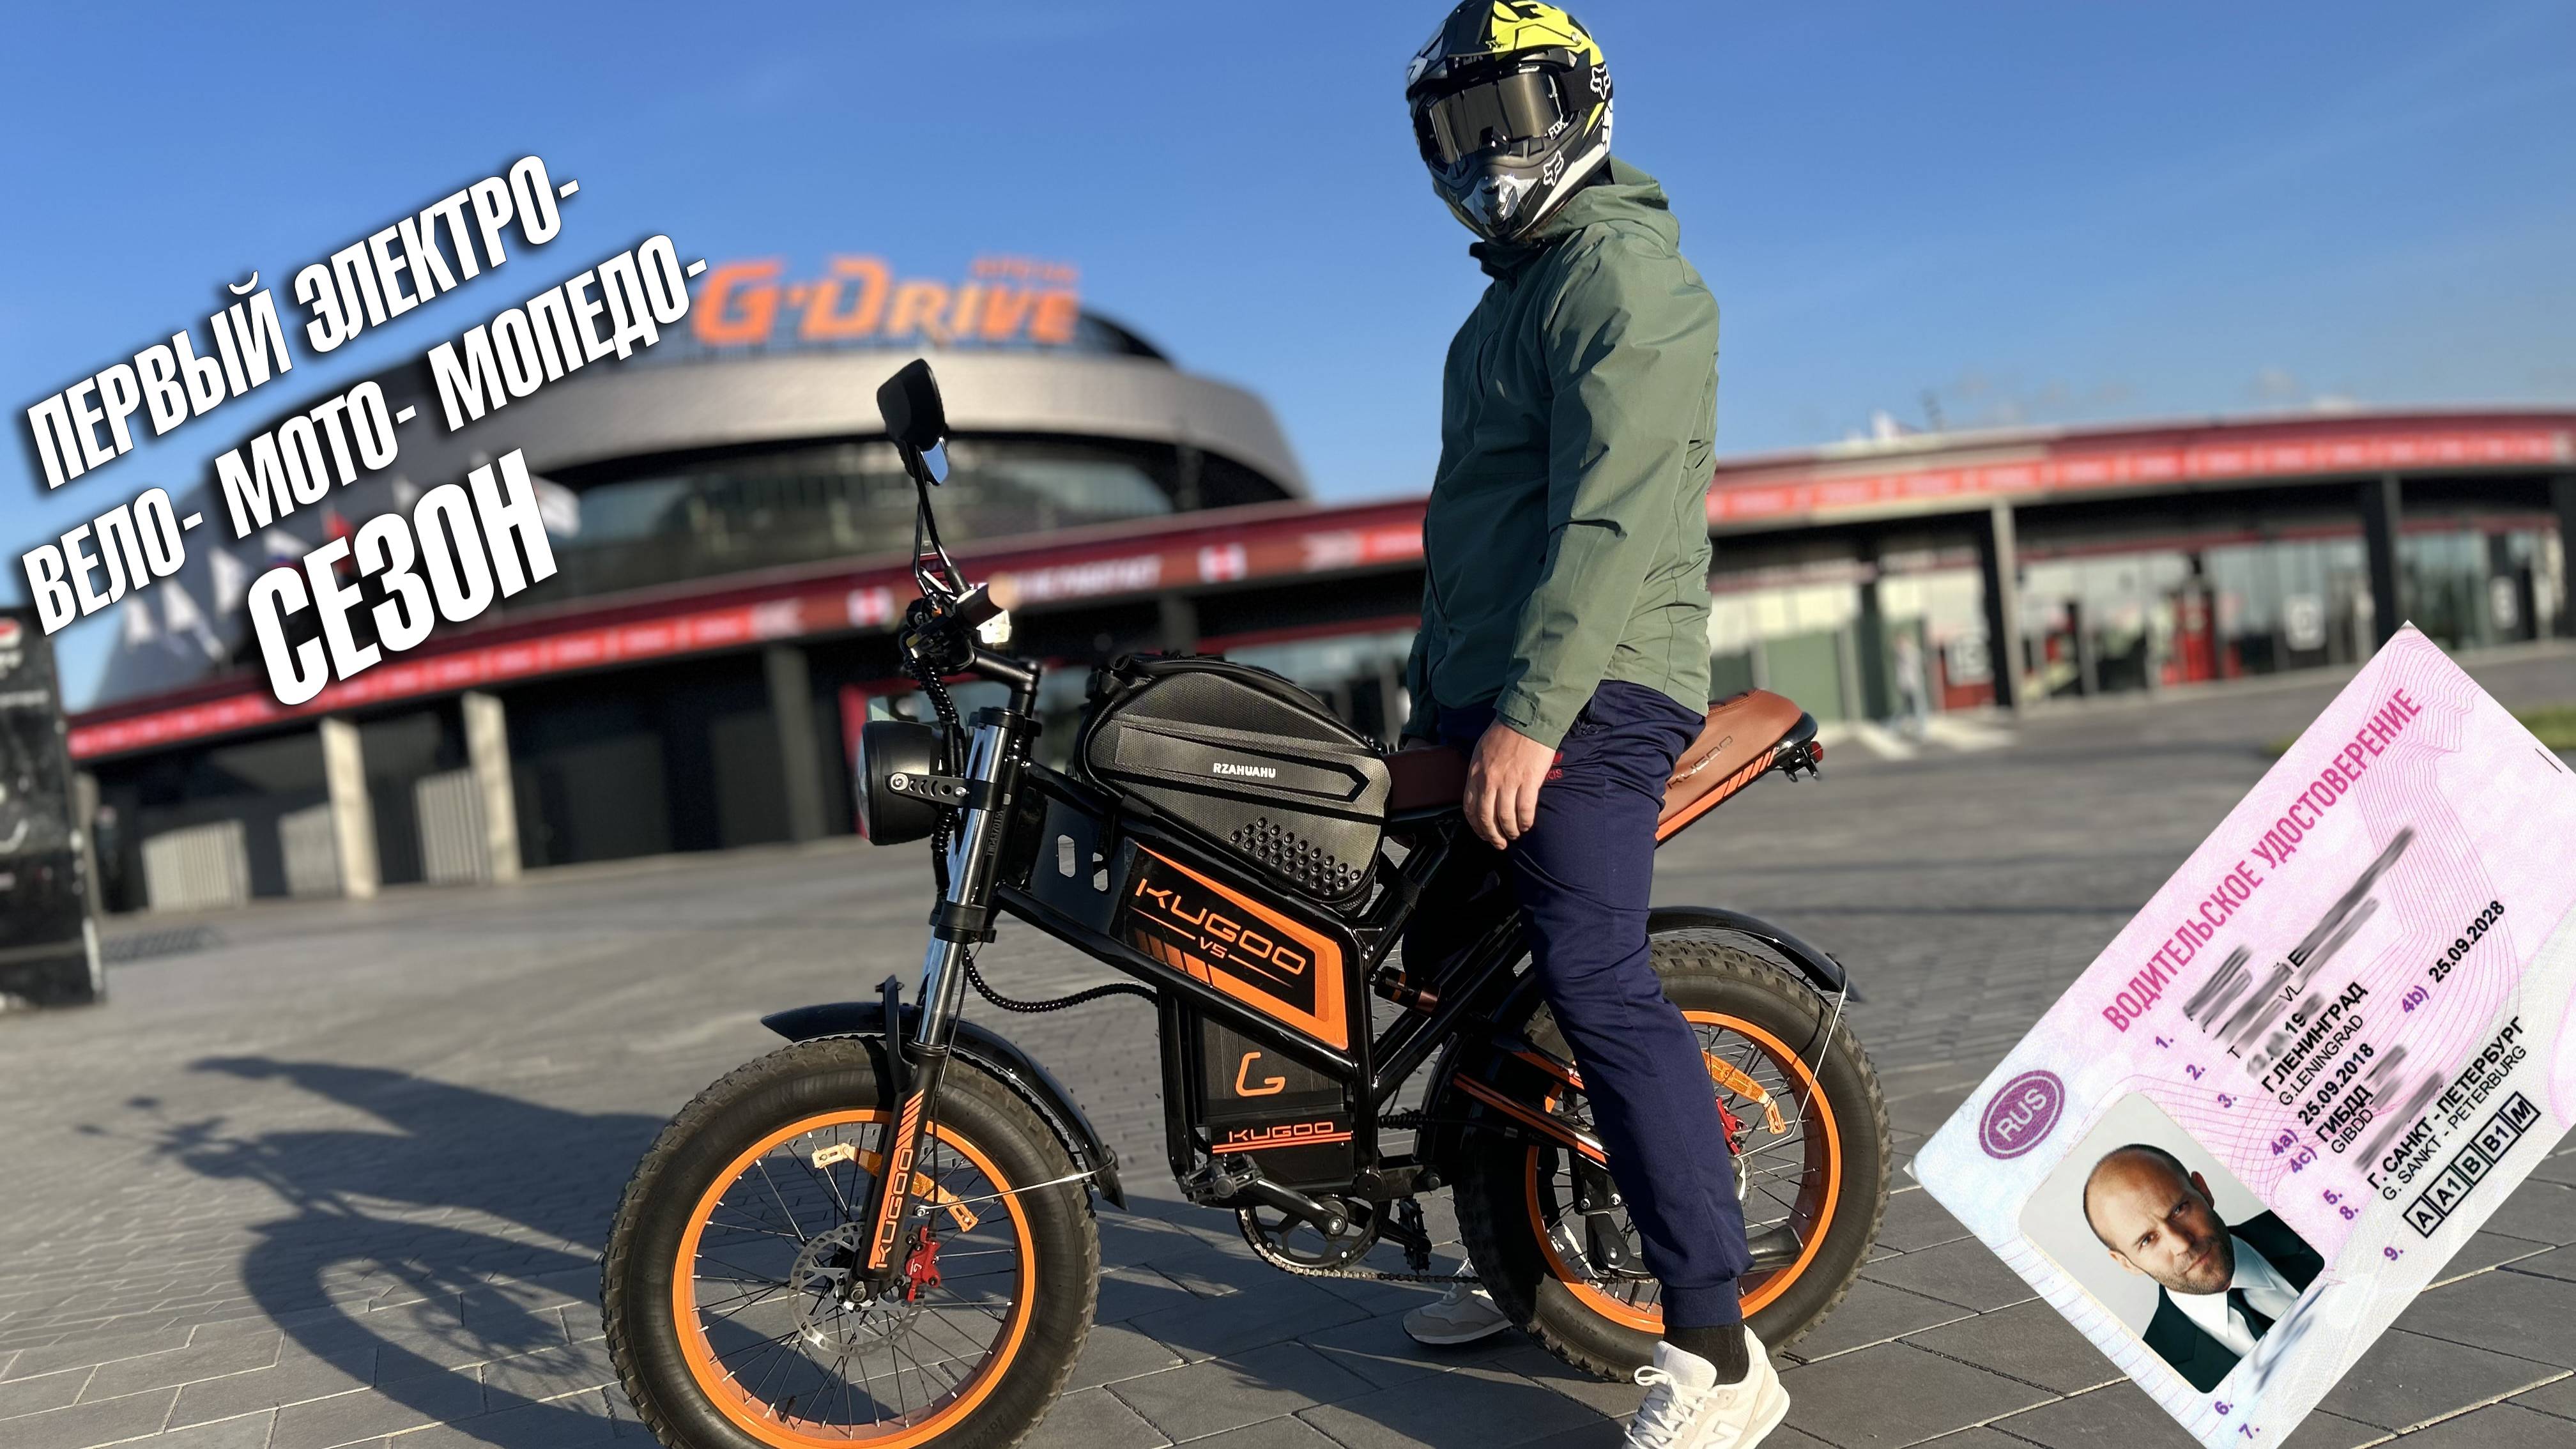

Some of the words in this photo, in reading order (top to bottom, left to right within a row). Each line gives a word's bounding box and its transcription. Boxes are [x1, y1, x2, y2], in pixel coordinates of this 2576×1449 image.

[1213, 762, 1276, 779] RZAHUAHU
[2103, 861, 2264, 1032] ВОДИТЕЛЬСКОЕ
[2252, 688, 2421, 869] УДОСТОВЕРЕНИЕ
[1135, 878, 1307, 975] KUGOO
[2402, 985, 2429, 1013] 4b)
[2428, 900, 2504, 983] 25.09.2028
[2156, 1036, 2174, 1048] 1.
[2186, 1064, 2206, 1080] 2.
[2218, 1094, 2237, 1108] 3.
[2271, 1128, 2299, 1156] 4a)
[2298, 1043, 2374, 1126] 25.09.2018
[2382, 1117, 2433, 1172] САНКТ
[2437, 1016, 2525, 1114] ПЕТЕРБУРГ
[1995, 1088, 2047, 1142] RUS
[2315, 1085, 2374, 1142] ГИБДД
[2398, 1138, 2442, 1184] SANKT
[2449, 1045, 2527, 1130] PETERBURG
[1229, 1121, 1335, 1144] KUGOO
[2331, 1108, 2374, 1154] GIBDD
[2290, 1145, 2318, 1173] 4c)
[875, 1147, 914, 1268] KUGOO
[2322, 1189, 2343, 1205] 5.
[2339, 1205, 2359, 1220] 8.
[2384, 1246, 2404, 1261] 9.
[2214, 1400, 2234, 1415] 6.
[2239, 1423, 2260, 1439] 7.
